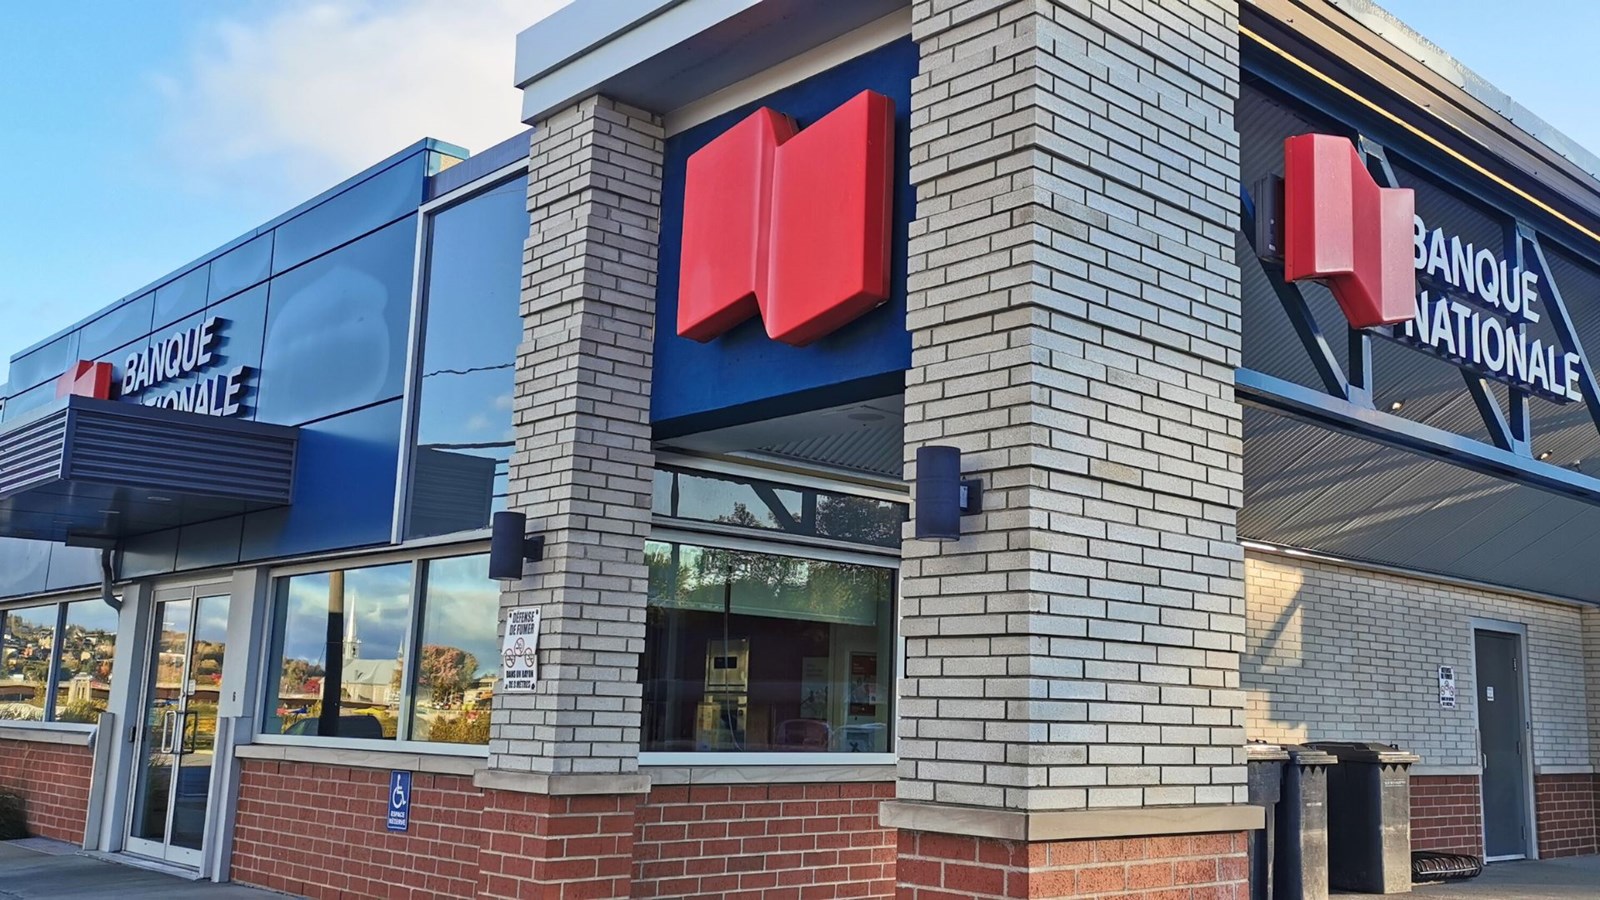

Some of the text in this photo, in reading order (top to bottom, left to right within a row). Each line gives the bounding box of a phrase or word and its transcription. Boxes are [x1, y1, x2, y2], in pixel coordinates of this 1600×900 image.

[1414, 213, 1540, 323] BANQUE
[122, 316, 218, 395] BANQUE
[140, 365, 245, 417] ONALE
[1405, 290, 1583, 403] NATIONALE
